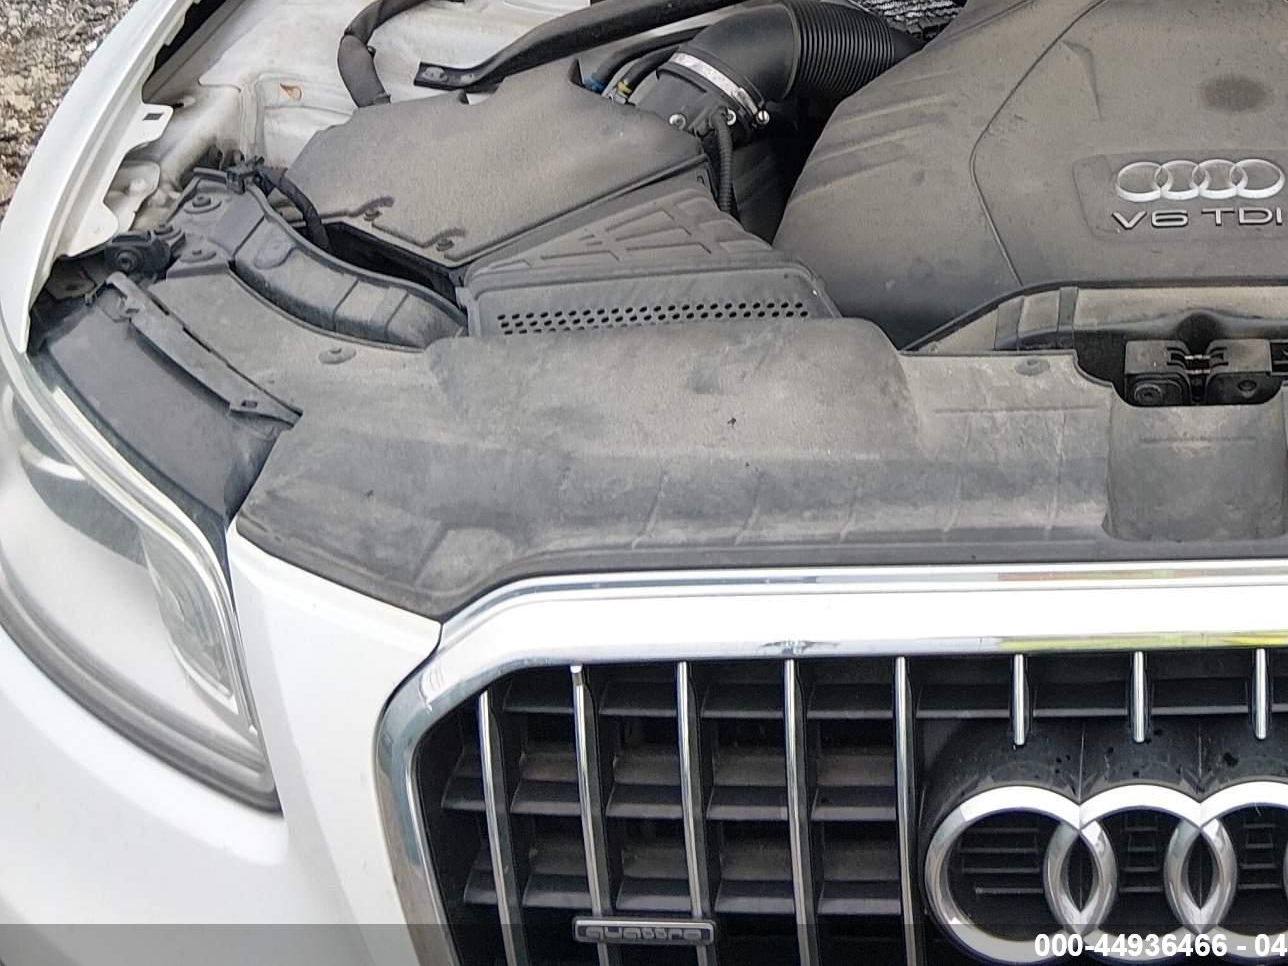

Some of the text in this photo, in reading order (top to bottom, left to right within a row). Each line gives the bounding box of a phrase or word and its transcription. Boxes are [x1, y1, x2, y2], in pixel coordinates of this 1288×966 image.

[1112, 206, 1284, 231] V6 TDI
[585, 925, 702, 941] quattro
